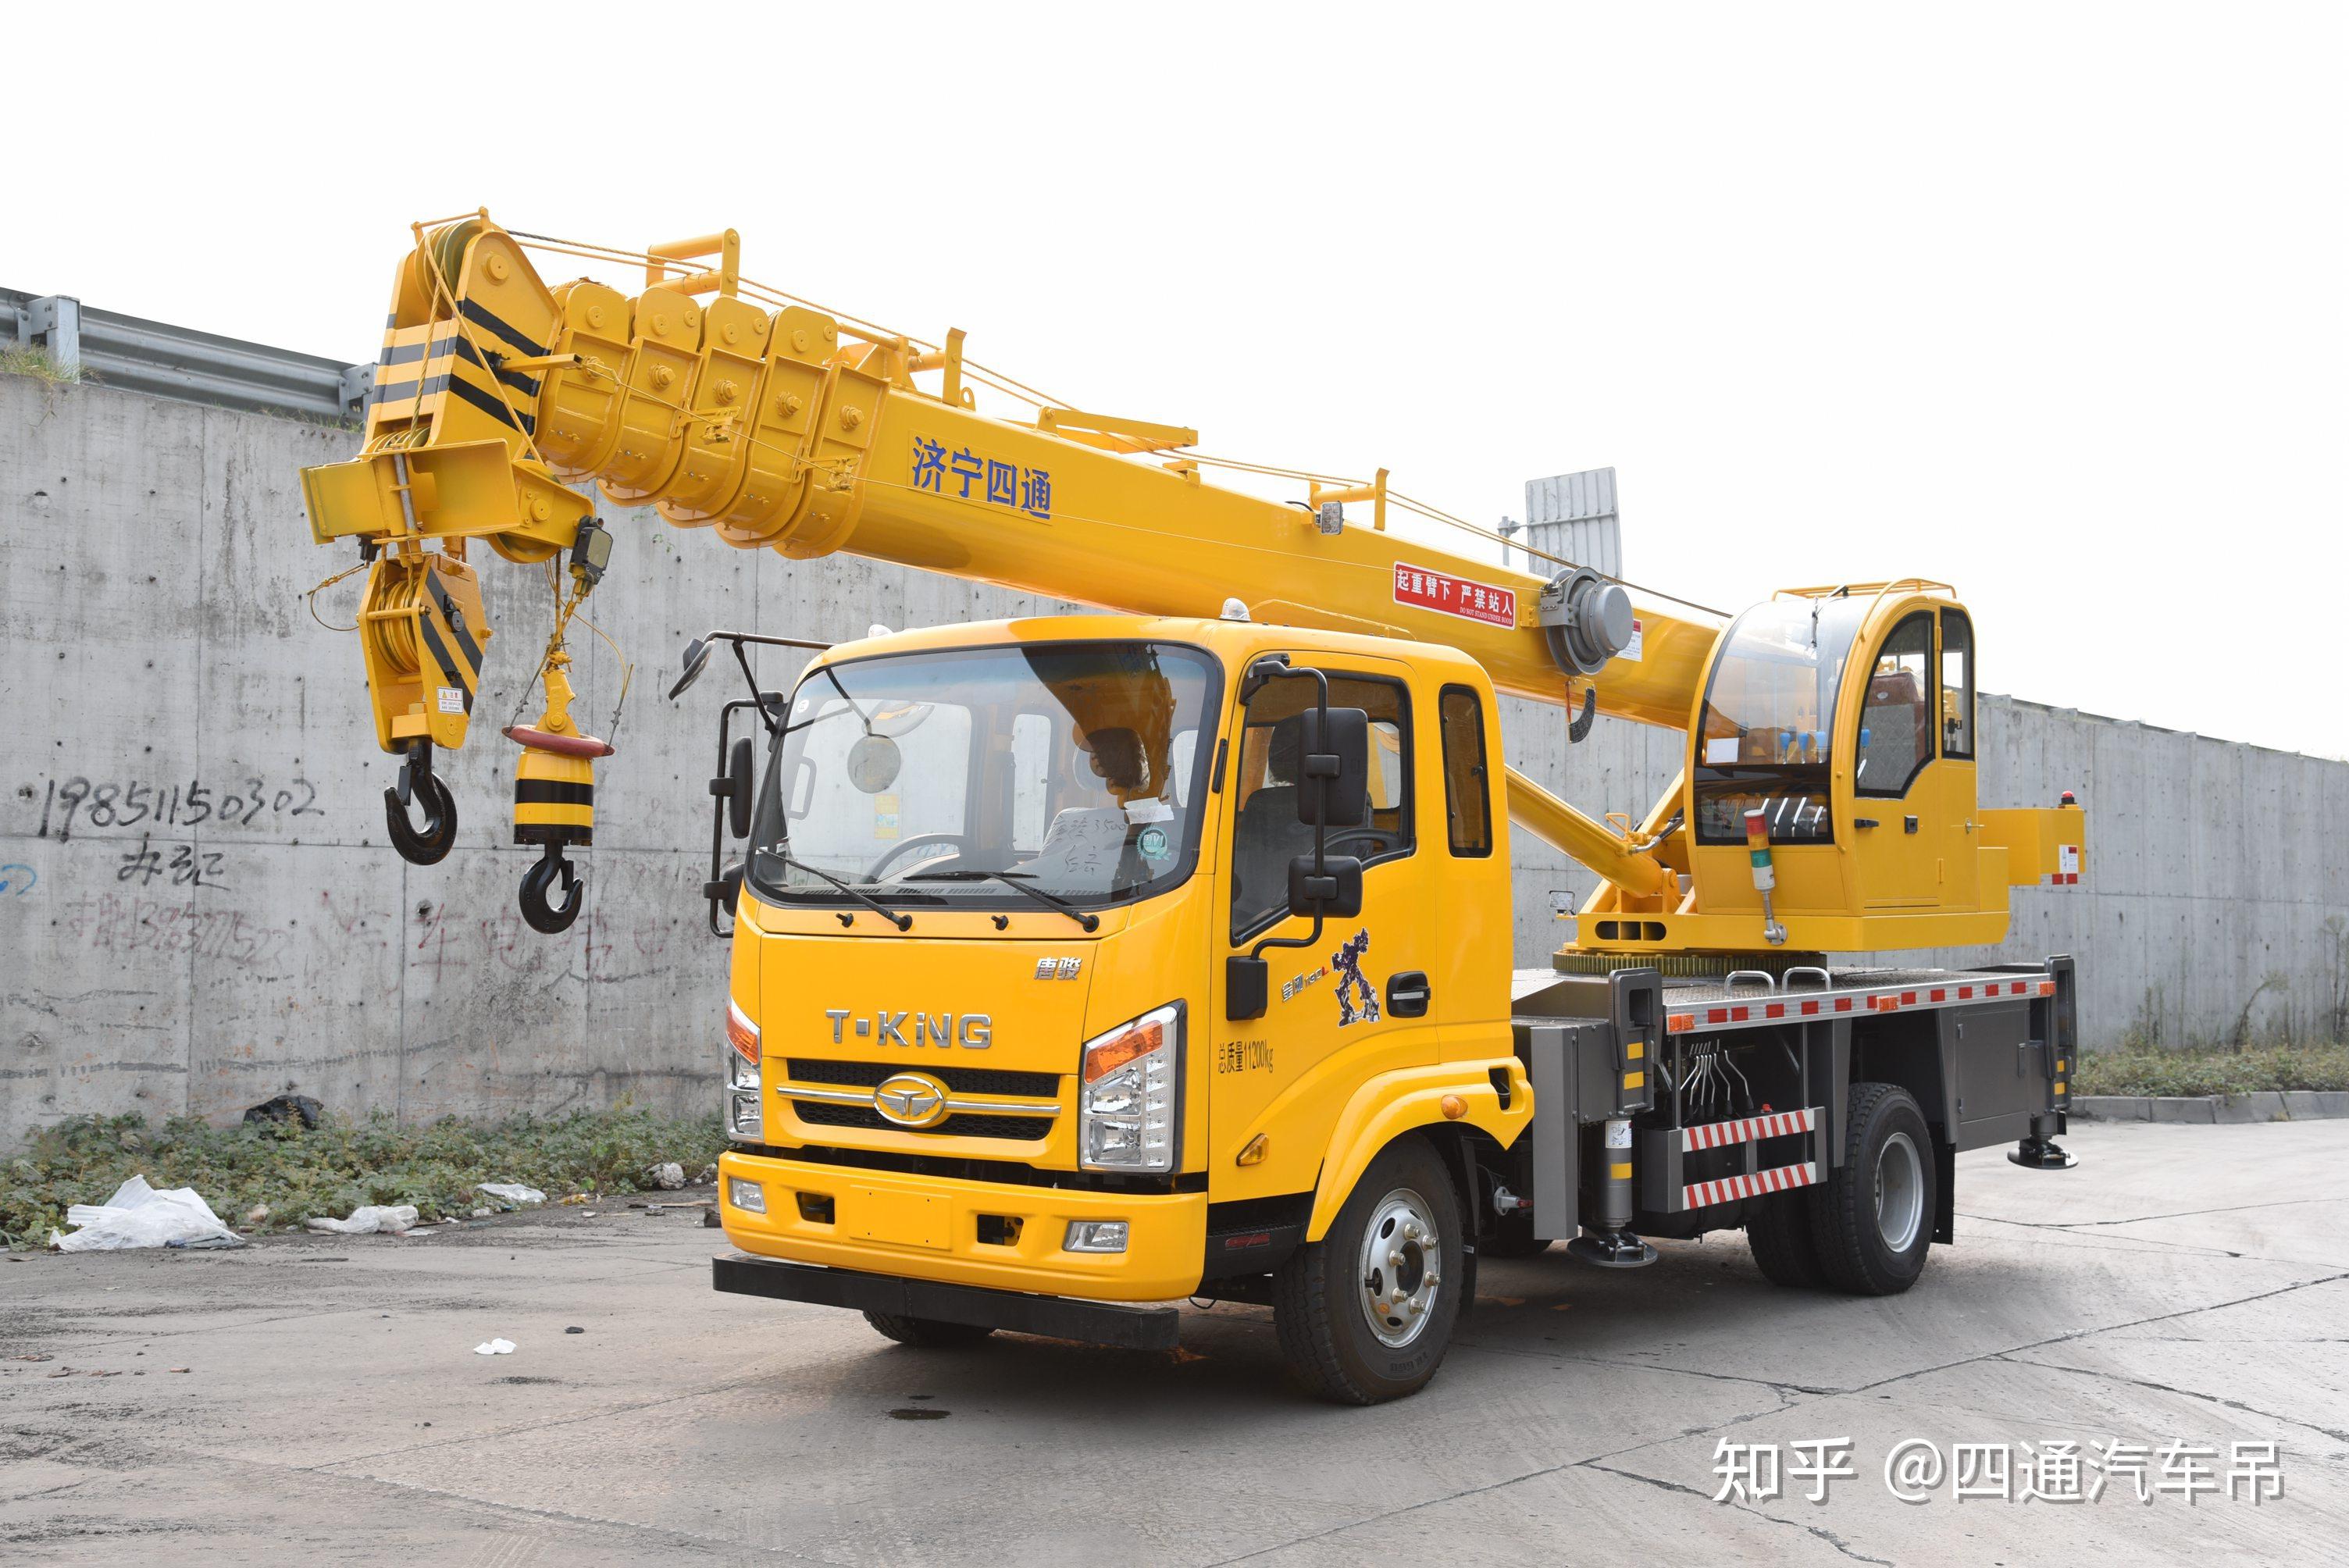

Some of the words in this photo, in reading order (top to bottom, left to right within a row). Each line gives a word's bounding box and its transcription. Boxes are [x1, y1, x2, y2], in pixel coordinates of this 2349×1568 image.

[912, 436, 1051, 520] 济宁四通
[1397, 568, 1451, 600] 起重臂下
[1461, 585, 1513, 616] 严禁站人
[1474, 610, 1488, 618] STAND
[1488, 613, 1501, 622] UNDER
[1501, 616, 1513, 625] BOOM
[1034, 957, 1082, 981] 唐骏
